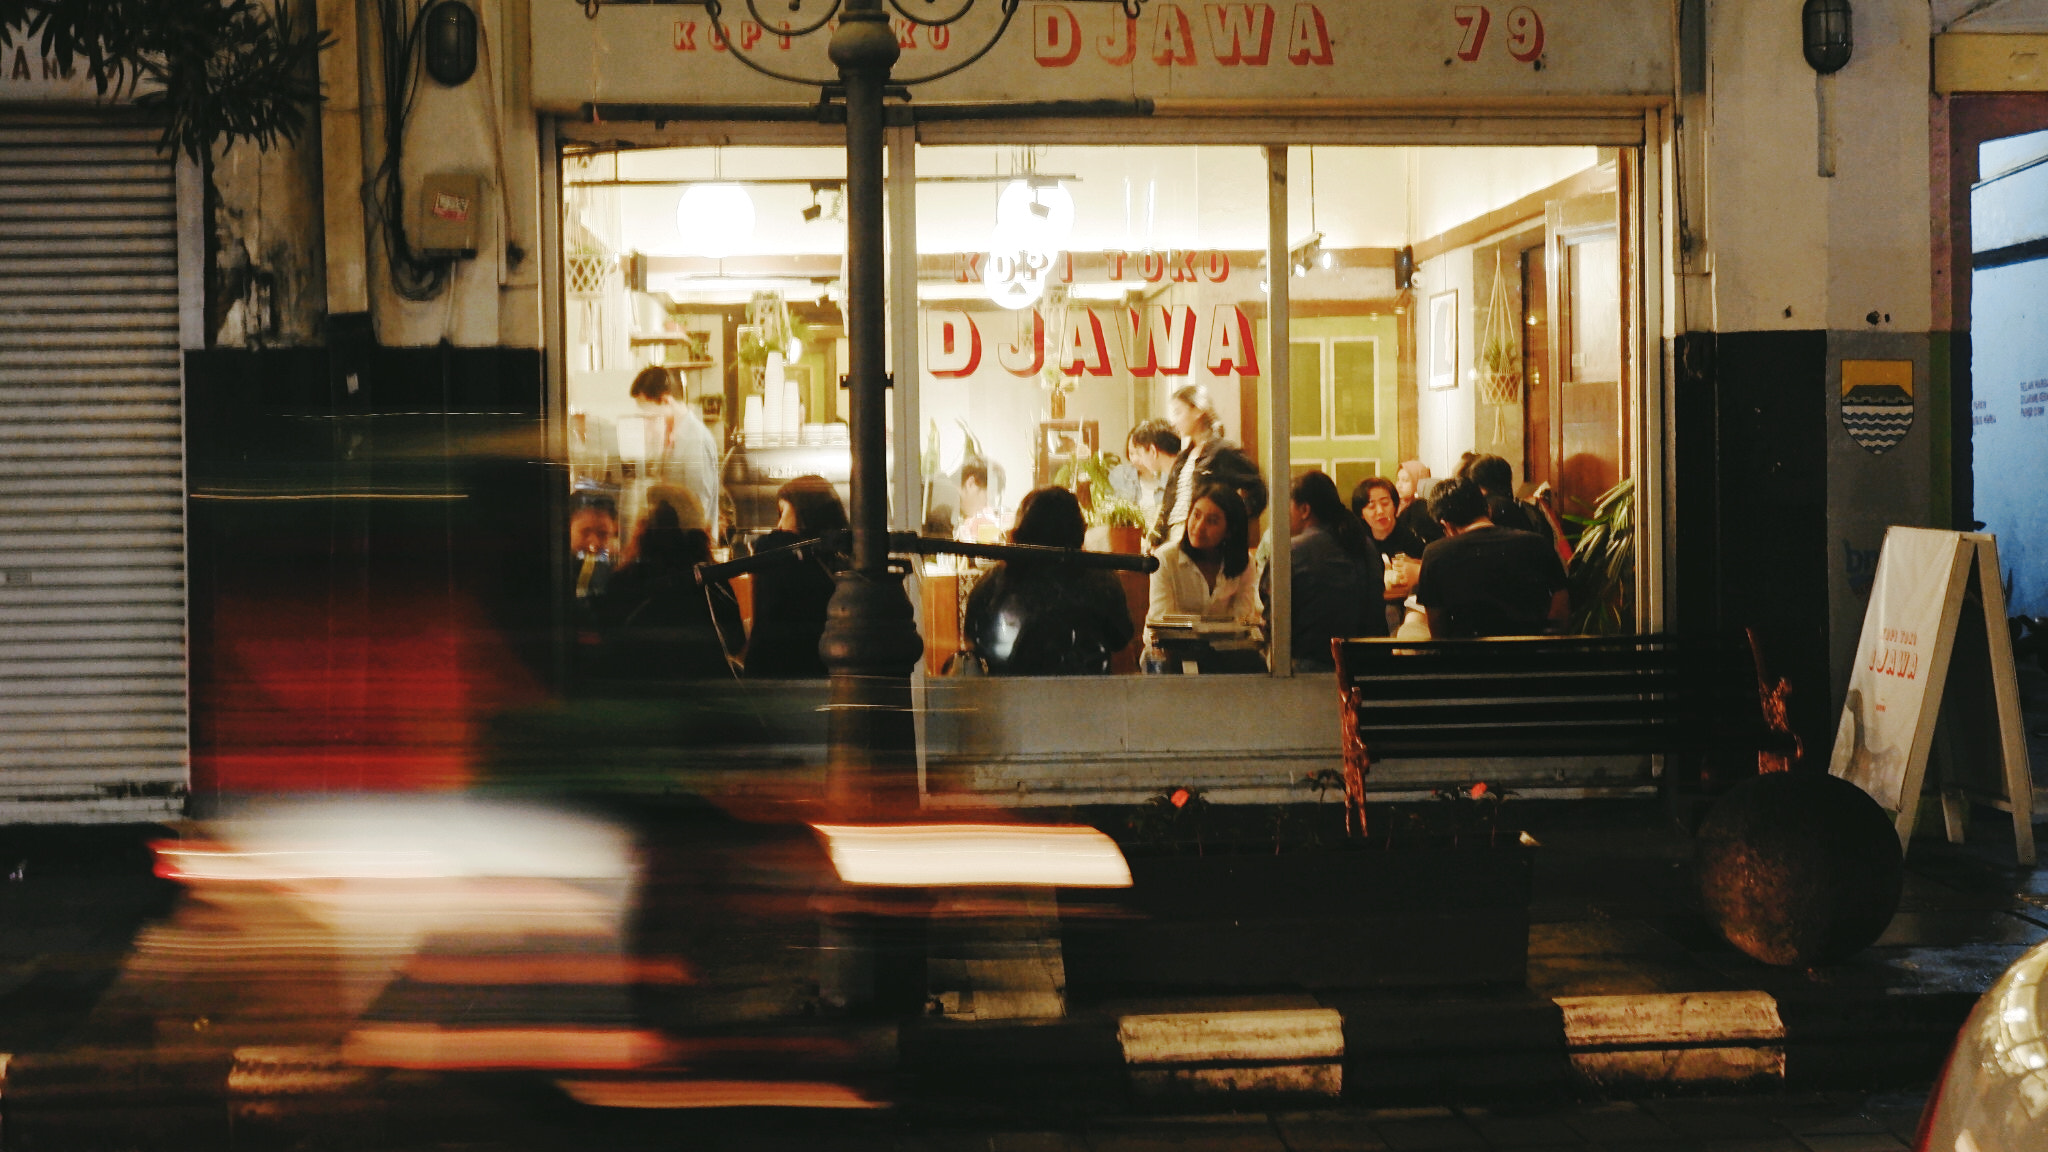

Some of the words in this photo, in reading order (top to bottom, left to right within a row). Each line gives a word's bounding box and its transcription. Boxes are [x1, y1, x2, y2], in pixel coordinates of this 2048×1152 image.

[674, 21, 791, 51] KOPI
[828, 20, 950, 50] KO
[1034, 4, 1334, 67] DJAWA
[1455, 6, 1545, 62] 79
[953, 251, 1073, 283] KOPI
[1103, 249, 1230, 282] TOKO
[926, 304, 1260, 378] DJAWA
